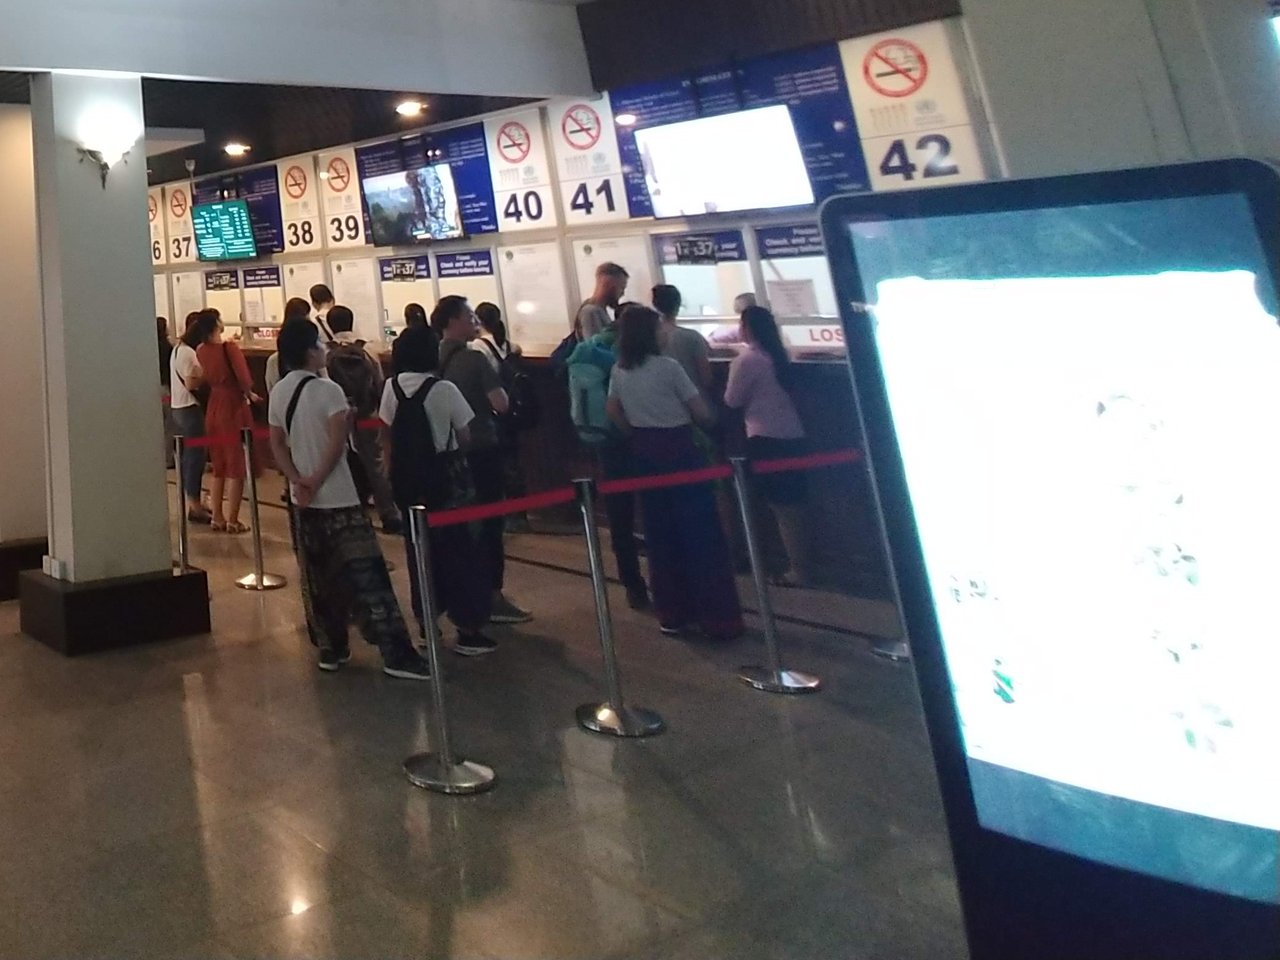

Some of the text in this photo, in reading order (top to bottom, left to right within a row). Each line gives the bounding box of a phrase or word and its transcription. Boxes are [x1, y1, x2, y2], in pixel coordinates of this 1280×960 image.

[880, 134, 959, 181] 42
[503, 190, 543, 223] 40
[570, 179, 615, 215] 41
[287, 221, 314, 246] 38
[330, 215, 359, 242] 39
[172, 236, 191, 258] 37
